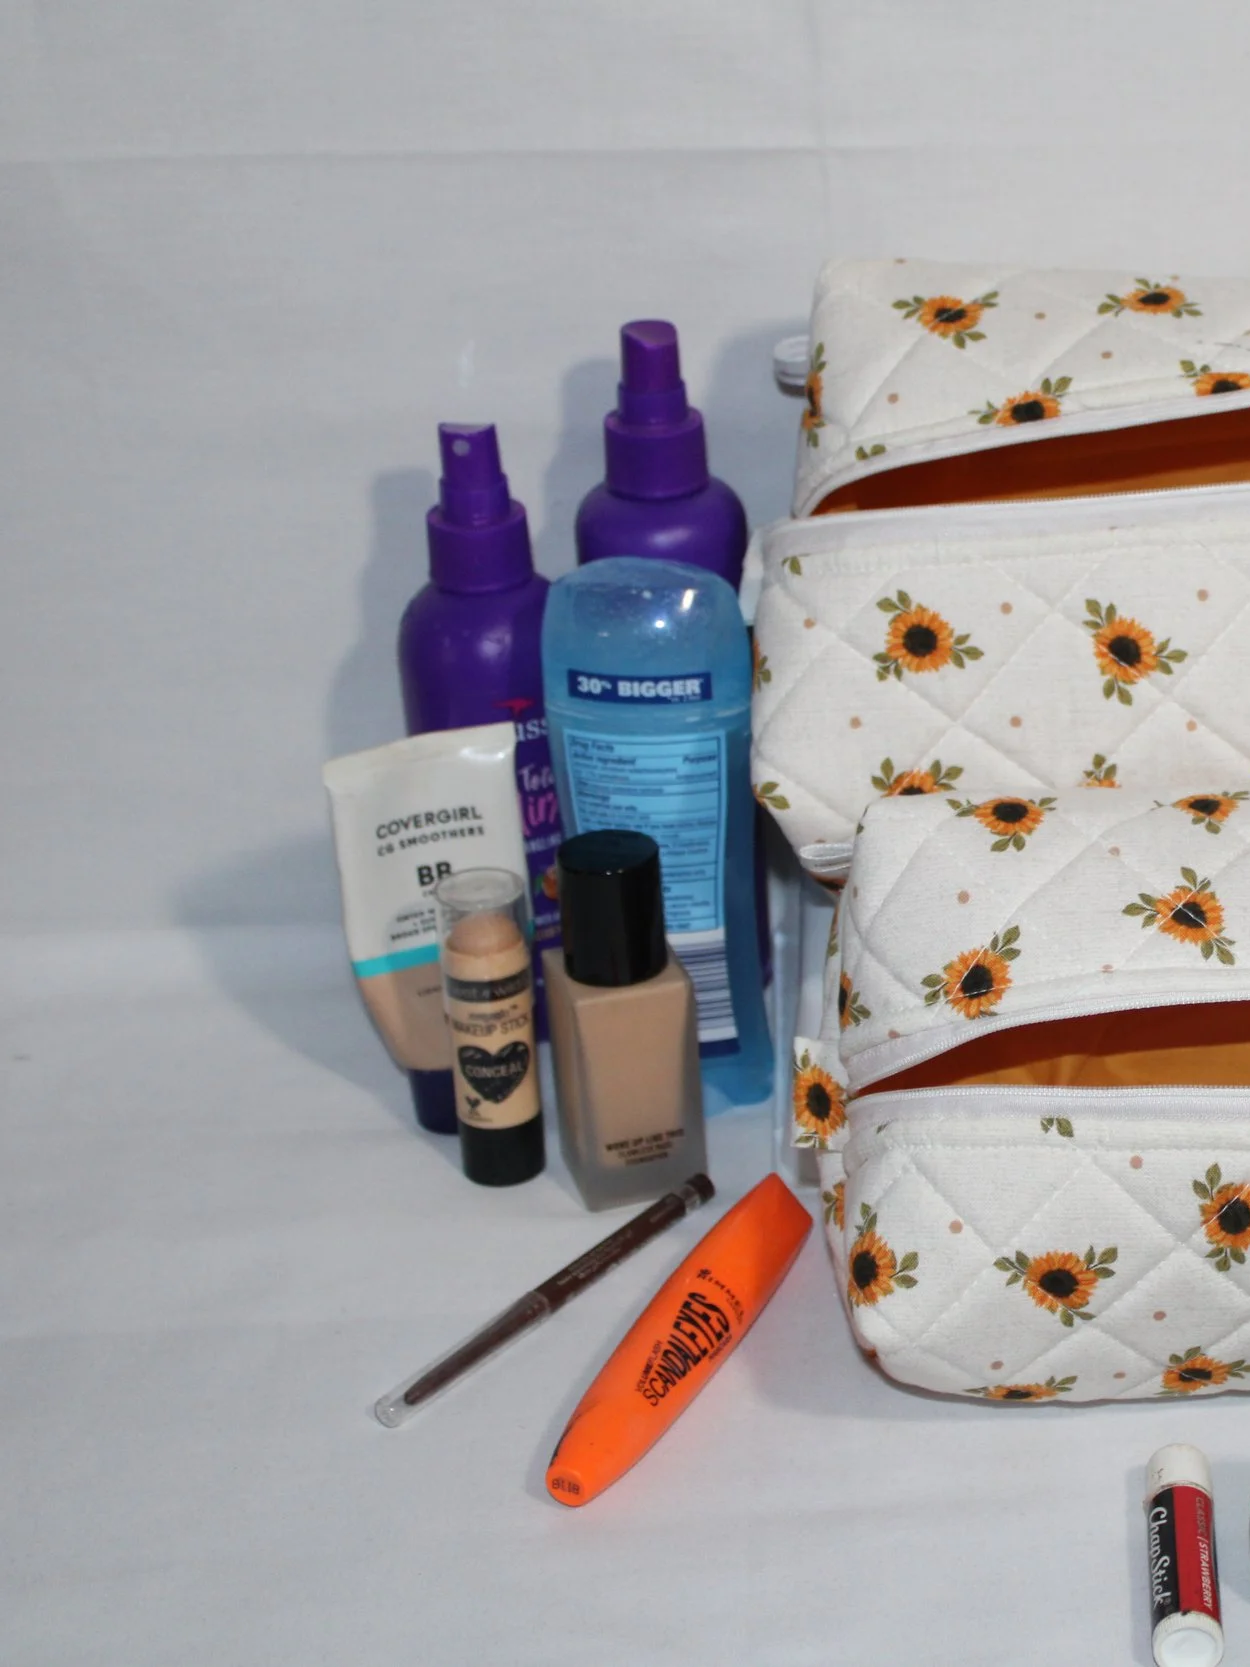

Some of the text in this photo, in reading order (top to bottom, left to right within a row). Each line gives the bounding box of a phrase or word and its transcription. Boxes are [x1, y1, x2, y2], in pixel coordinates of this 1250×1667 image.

[617, 678, 702, 698] BIGGER
[376, 806, 482, 839] COVERGIRL
[398, 825, 484, 849] SMOOTHERS
[465, 1060, 524, 1078] CONCEAL
[643, 1292, 729, 1407] SCANDALEYES
[1149, 1506, 1171, 1609] ChapStick
